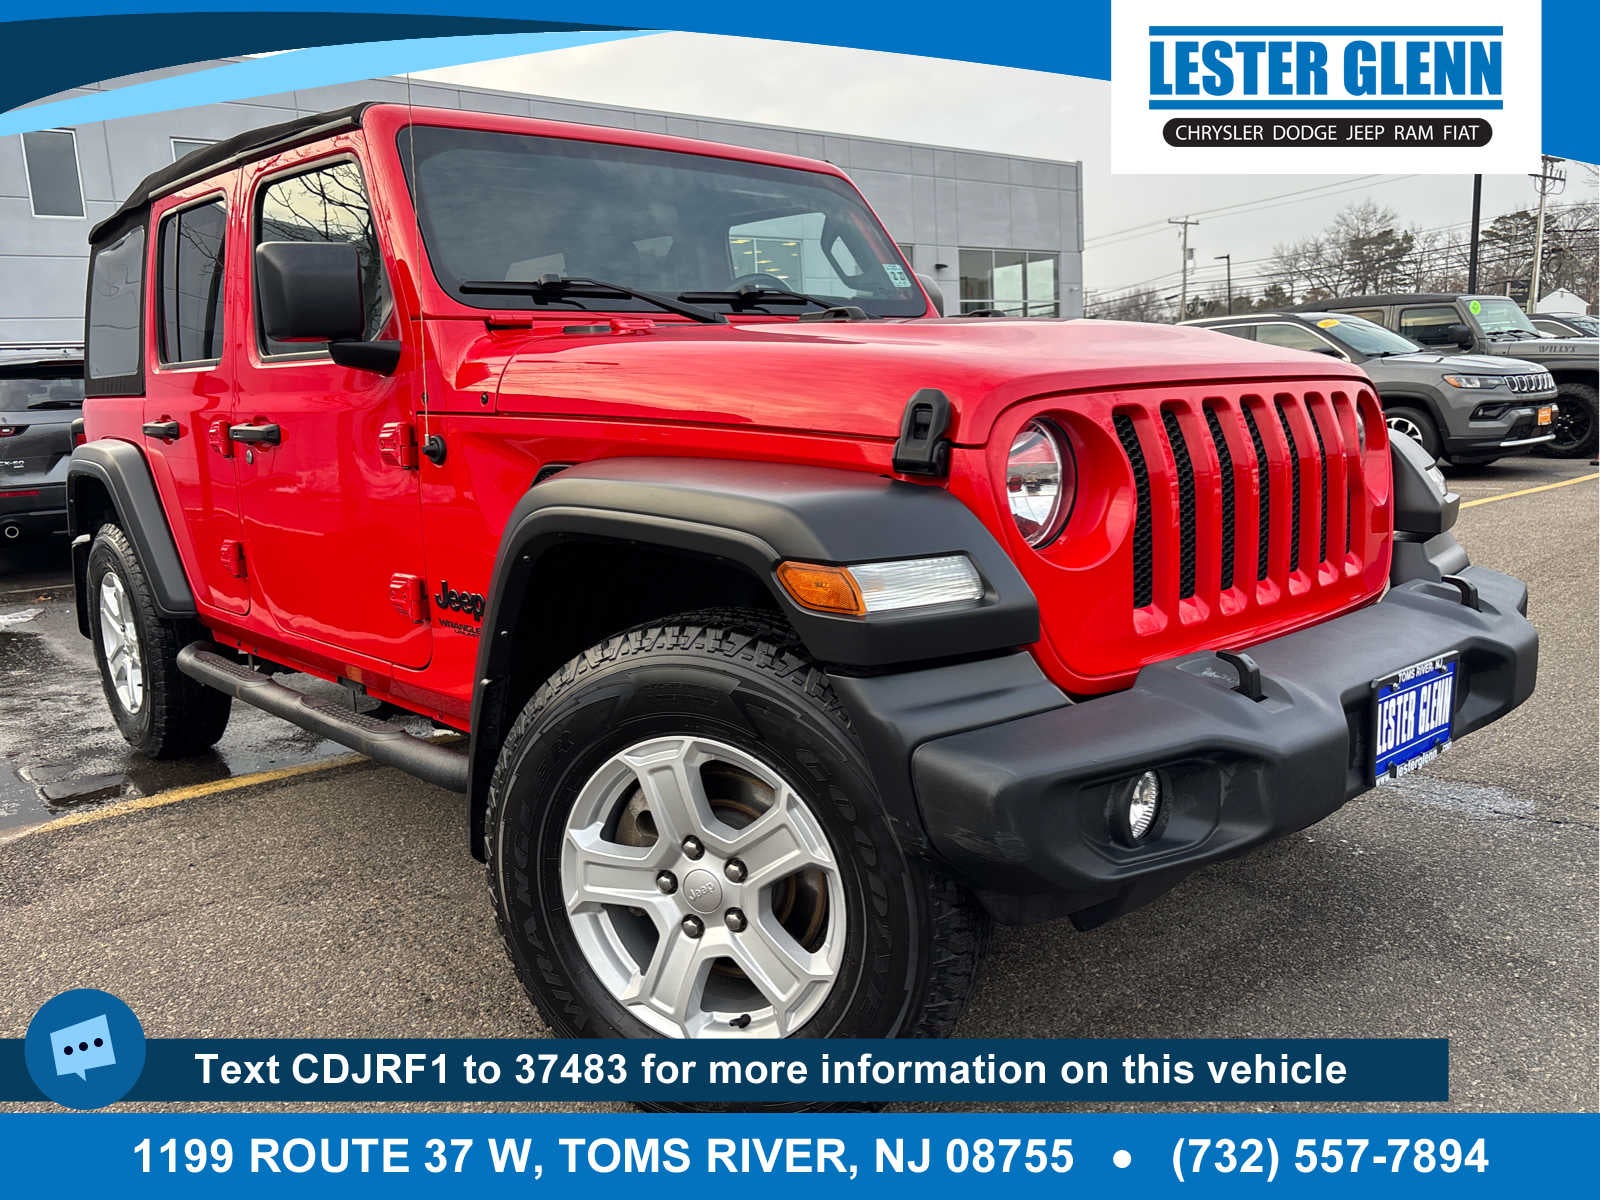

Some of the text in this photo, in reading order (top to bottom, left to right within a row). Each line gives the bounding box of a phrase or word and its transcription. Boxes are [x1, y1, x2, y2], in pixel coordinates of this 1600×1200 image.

[434, 579, 486, 622] Jeep
[1398, 668, 1416, 683] TOMS
[1376, 676, 1453, 757] LESTER GLENN
[689, 882, 713, 901] Jeep
